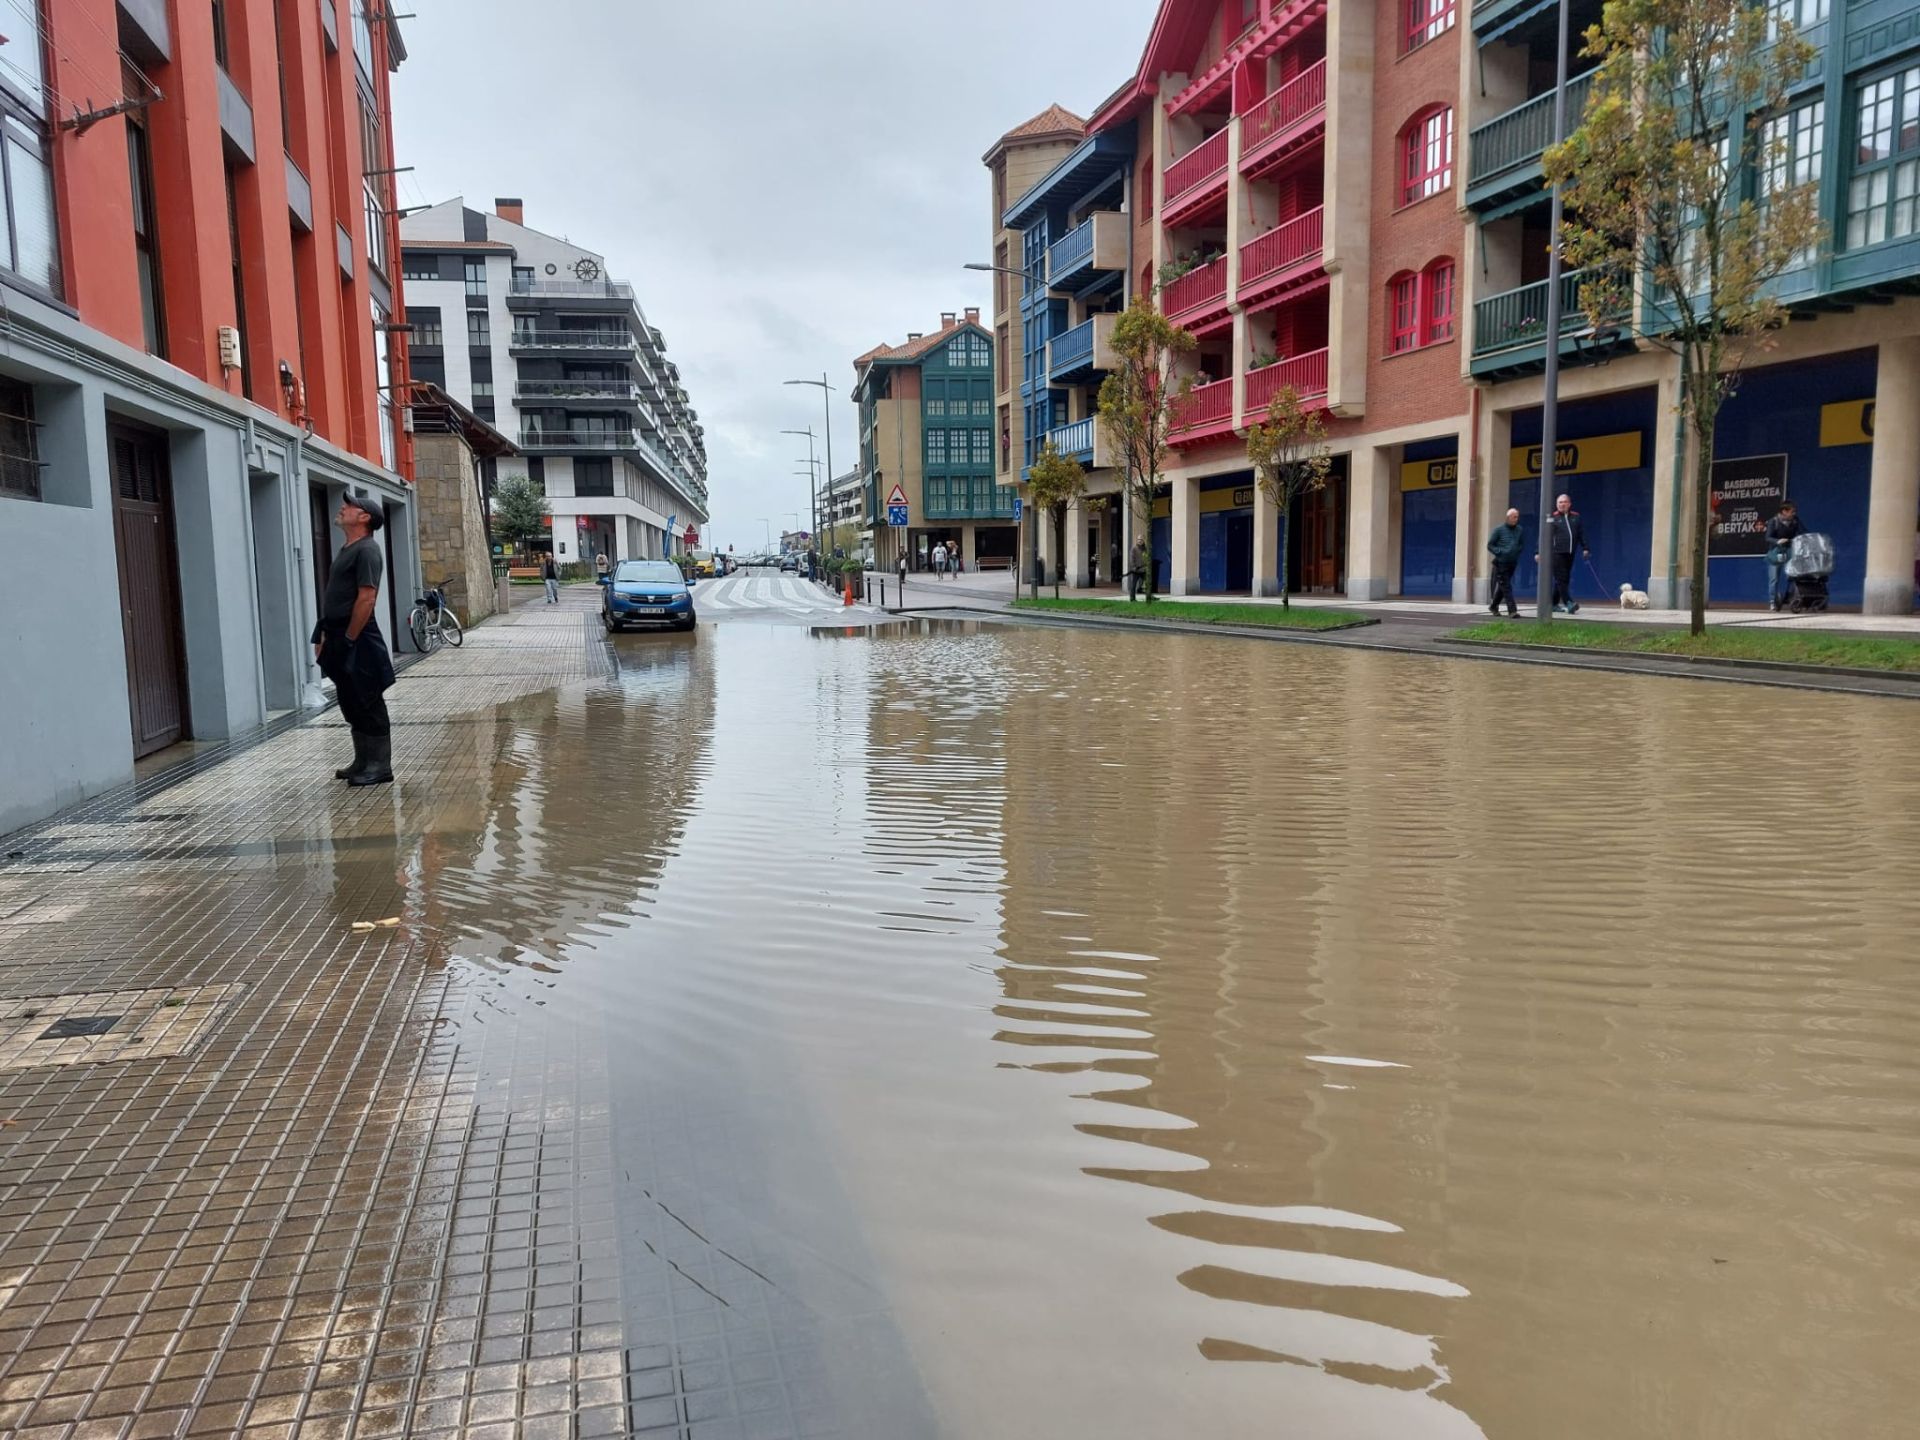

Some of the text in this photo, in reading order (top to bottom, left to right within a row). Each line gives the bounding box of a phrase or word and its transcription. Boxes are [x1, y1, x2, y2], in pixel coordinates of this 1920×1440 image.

[1724, 478, 1770, 489] BASERRIKO
[1713, 487, 1780, 500] TOMATEA IZATEA
[1731, 511, 1758, 522] SUPER
